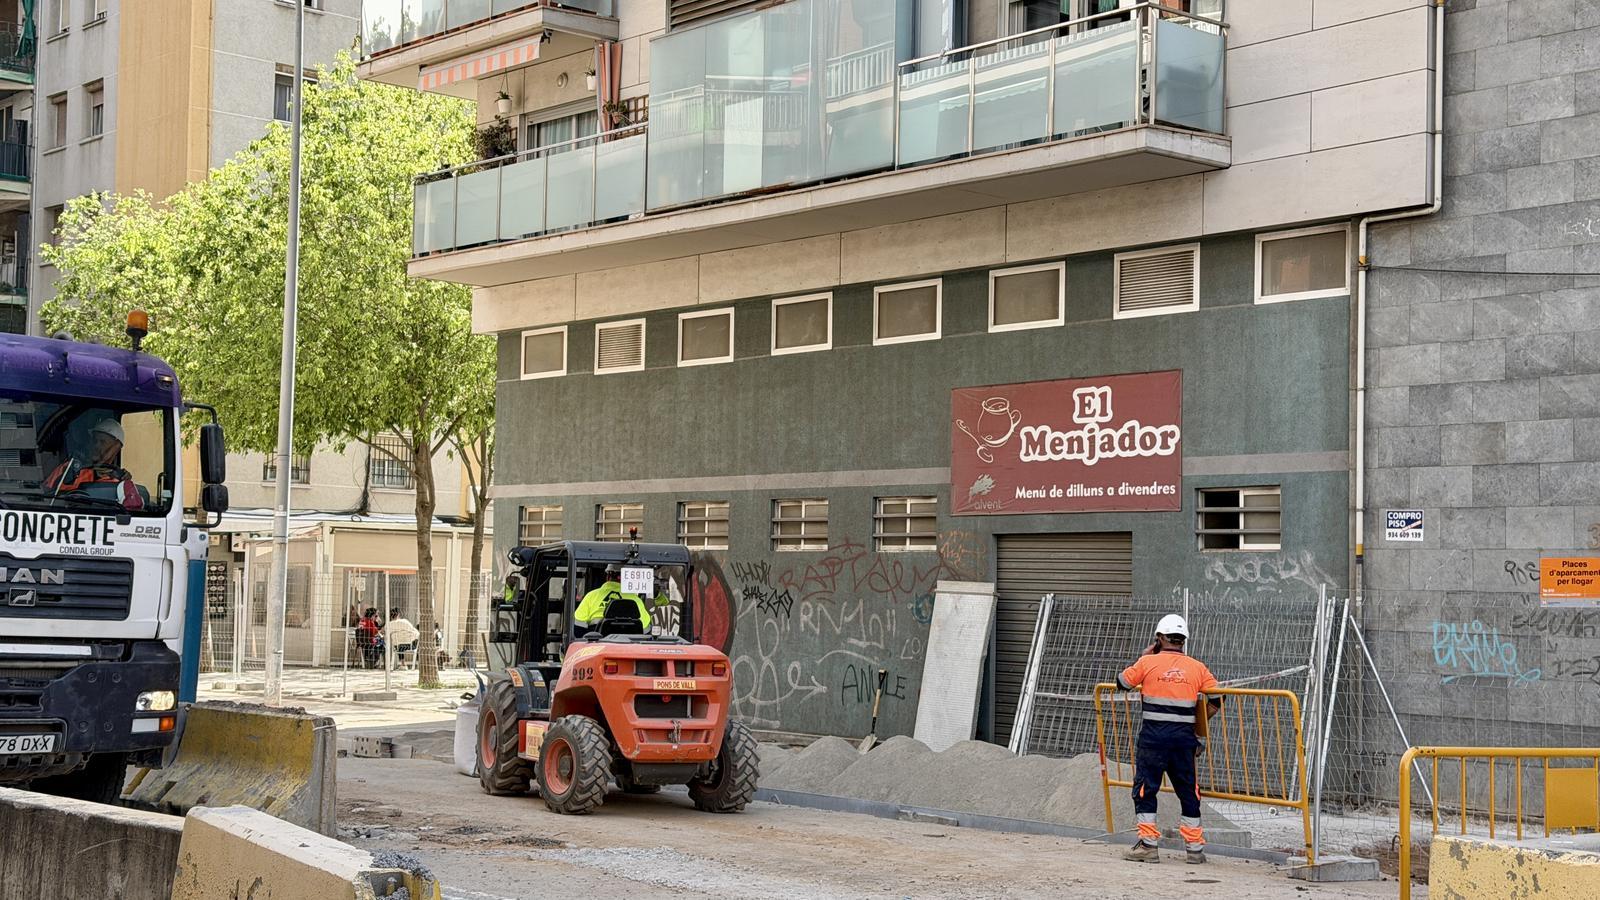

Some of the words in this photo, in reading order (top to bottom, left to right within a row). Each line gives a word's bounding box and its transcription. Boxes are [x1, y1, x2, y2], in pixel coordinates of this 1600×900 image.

[1074, 387, 1111, 422] El
[1020, 420, 1180, 466] Menjador
[1015, 485, 1046, 499] Menú
[1049, 484, 1063, 497] de
[1066, 482, 1104, 497] dilluns
[1107, 486, 1115, 496] a
[1118, 481, 1176, 495] divendres
[1387, 512, 1422, 520] COMPRO
[0, 511, 116, 546] ONCRETE
[1388, 520, 1406, 528] PISO
[59, 545, 89, 555] CONDAL
[90, 547, 115, 556] GROUP
[1561, 560, 1588, 568] Places
[1571, 578, 1594, 586] llogar
[21, 737, 51, 751] DXX
